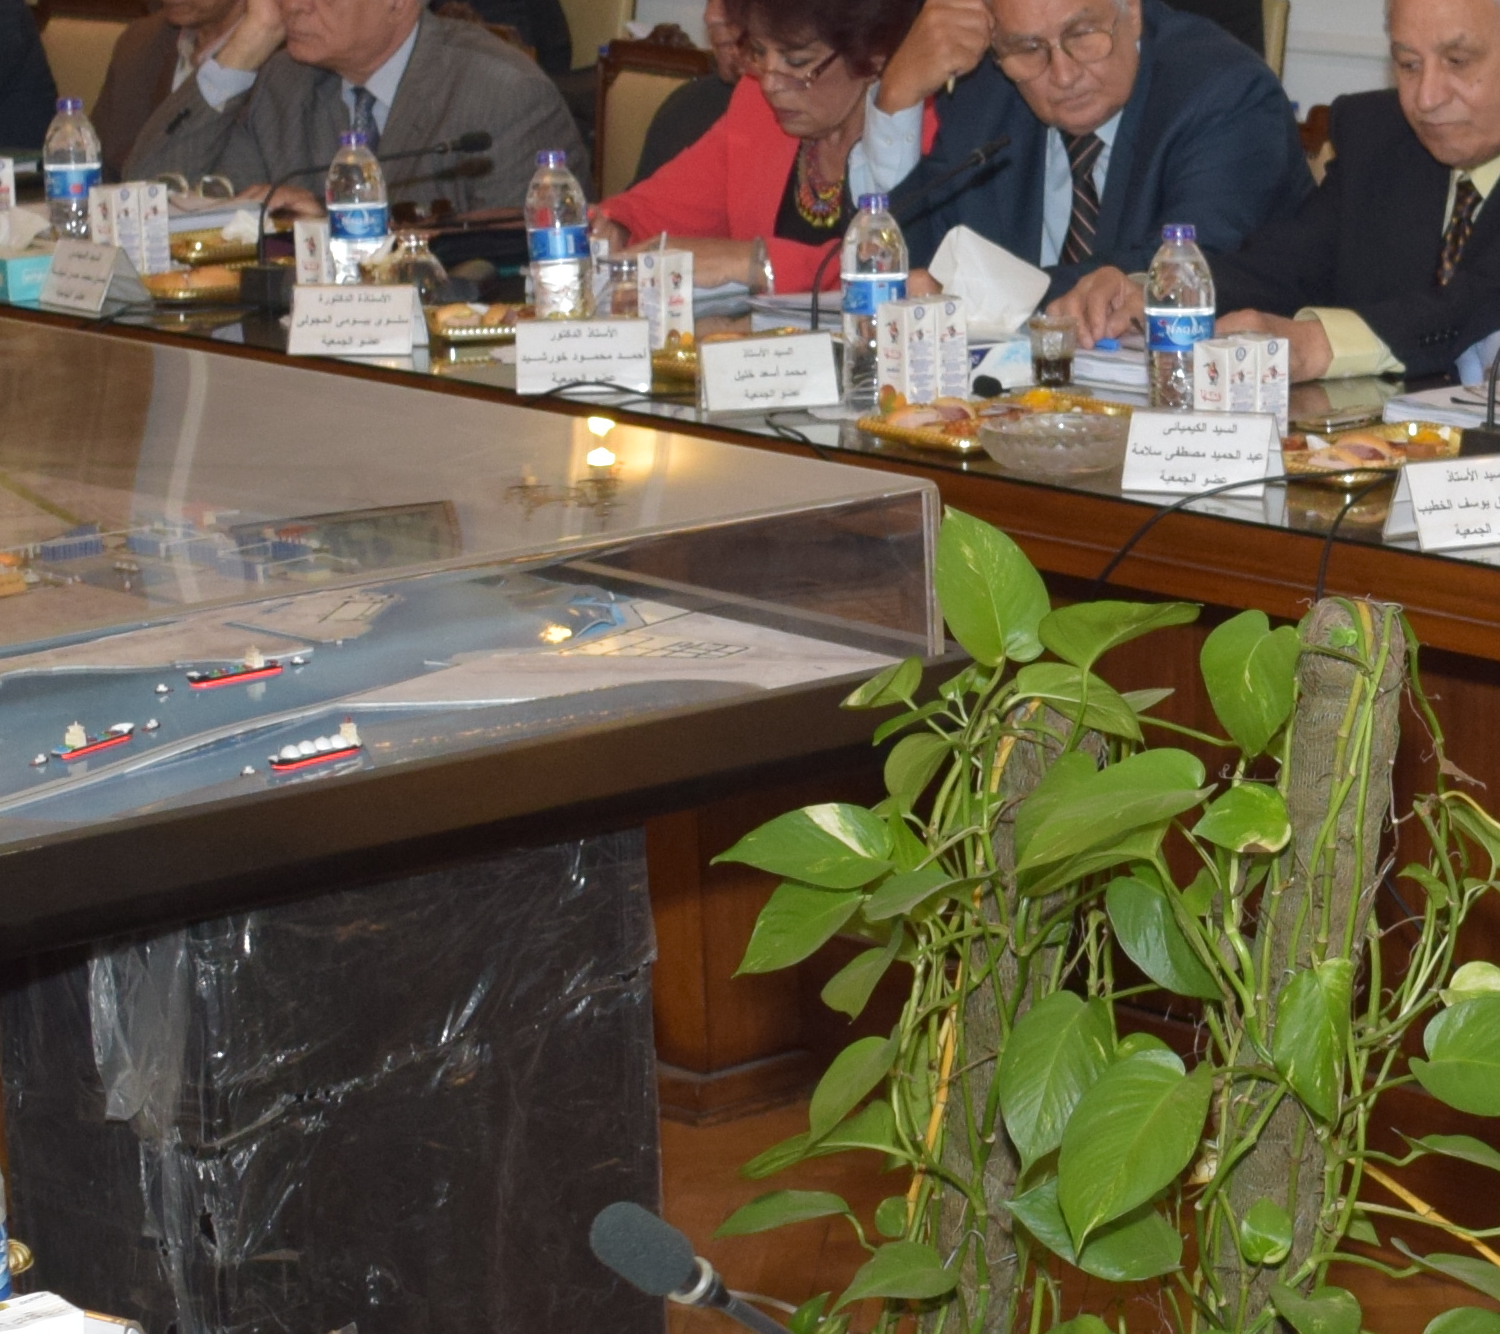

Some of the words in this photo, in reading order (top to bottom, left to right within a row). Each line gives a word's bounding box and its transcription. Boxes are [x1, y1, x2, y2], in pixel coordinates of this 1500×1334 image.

[550, 327, 582, 342] الدكتور
[572, 353, 613, 364] محمود
[616, 350, 647, 362] أحمد
[770, 347, 794, 359] السيد
[782, 370, 807, 380] محمد
[1212, 424, 1238, 435] السيد
[1131, 444, 1162, 457] سلامة
[1164, 450, 1206, 461] مصطفى
[1211, 450, 1241, 461] الحميد
[1246, 452, 1263, 464] عبد
[1159, 471, 1197, 485] الجمعية
[1202, 475, 1228, 487] عضو
[1447, 469, 1479, 483] الأستاذ
[1417, 500, 1453, 515] الخطيب
[1457, 496, 1491, 511] يوسف
[1454, 522, 1492, 538] الجمعية
